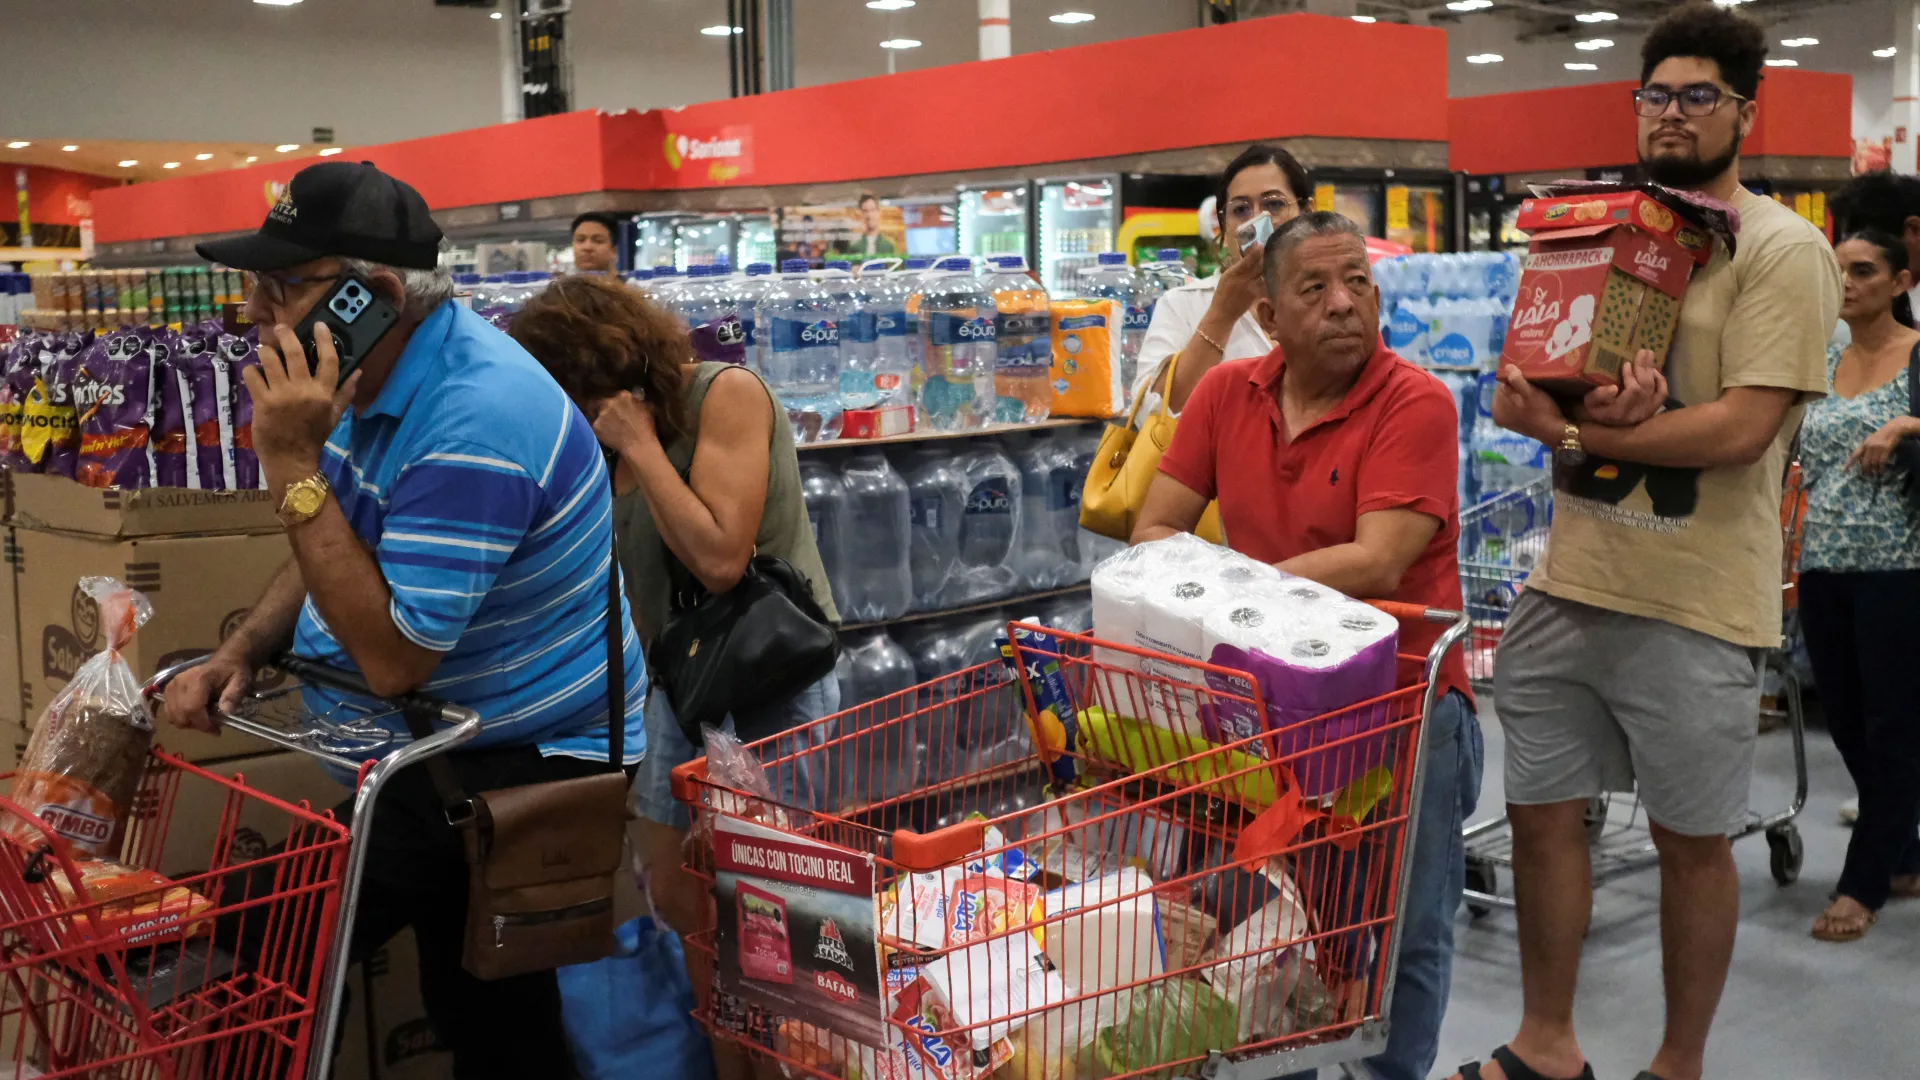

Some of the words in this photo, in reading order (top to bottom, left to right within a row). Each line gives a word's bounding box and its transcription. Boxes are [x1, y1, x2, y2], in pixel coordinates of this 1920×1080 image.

[1532, 250, 1605, 268] AHORRAPACK
[1633, 250, 1668, 271] LALA
[1513, 301, 1560, 330] LALA
[157, 489, 236, 508] SALVEMOS
[41, 809, 110, 841] BIMBO
[731, 839, 766, 868] ÚNICAS
[766, 849, 787, 873] CON
[787, 853, 825, 879] TOCINO
[826, 859, 855, 884] REAL
[954, 889, 977, 932] LALA
[819, 935, 845, 950] JEFES
[814, 945, 854, 972] ASADOR
[817, 974, 855, 999] BAFAR
[906, 1014, 953, 1068] LALA
